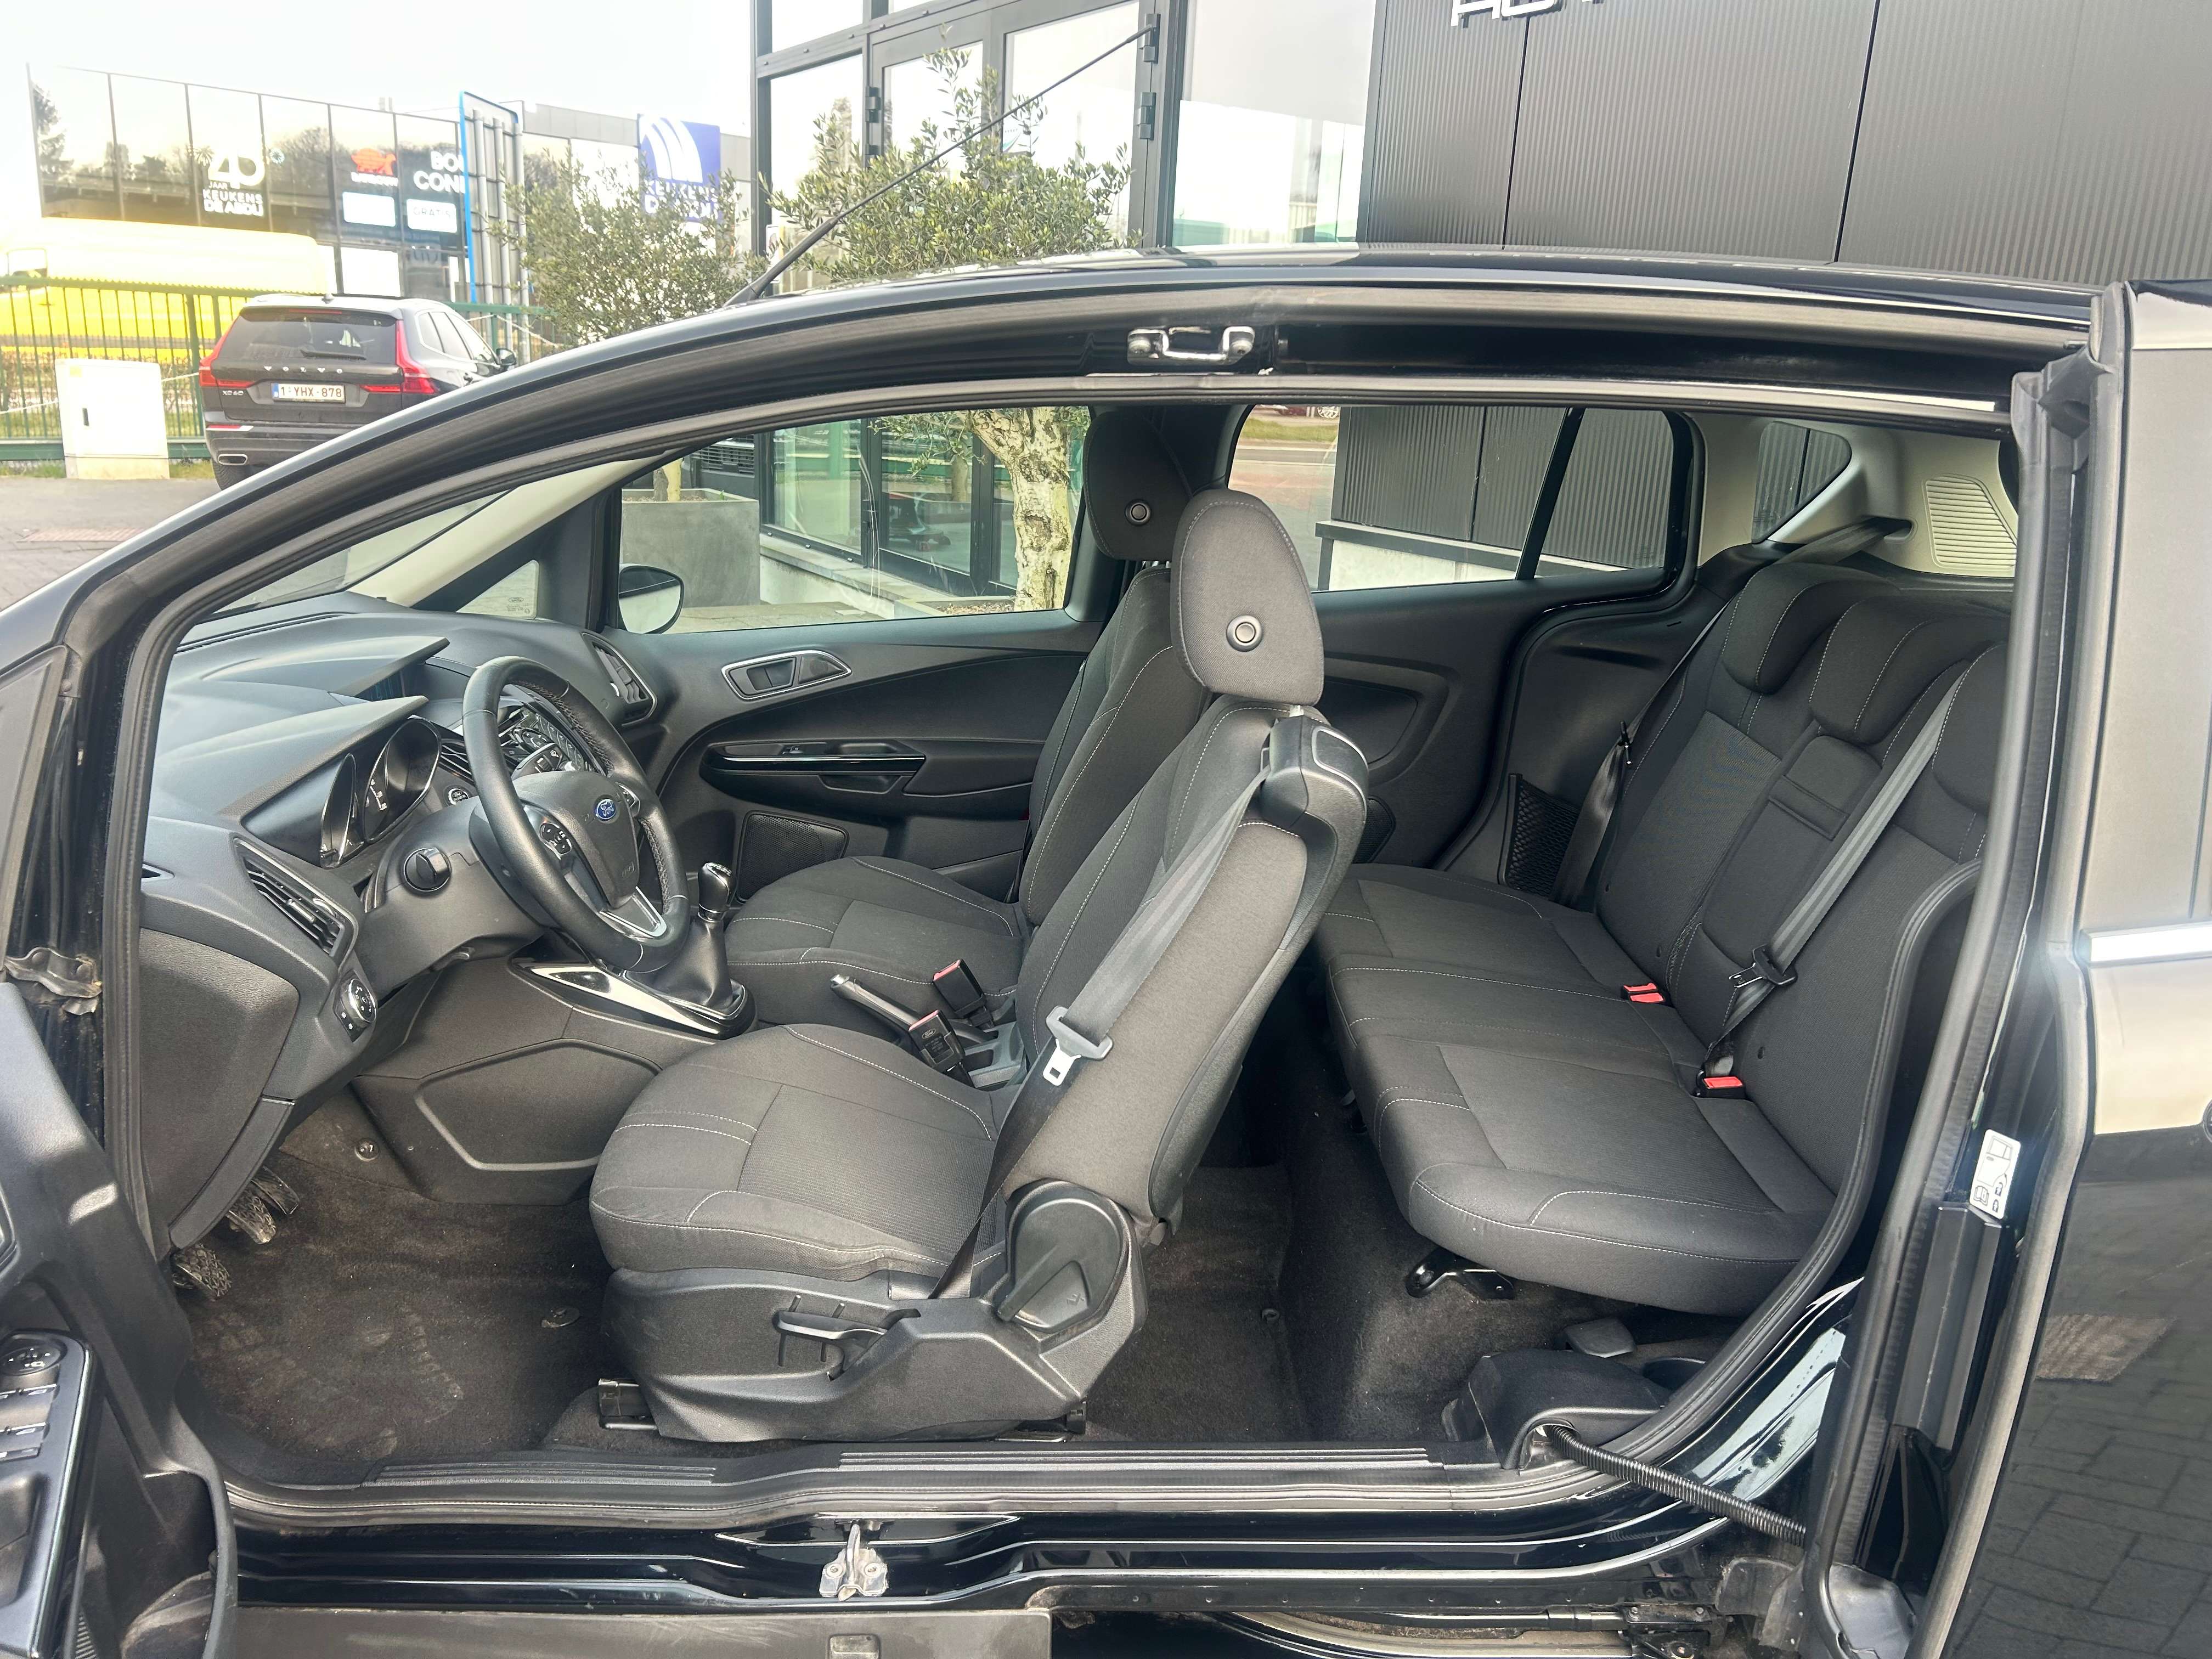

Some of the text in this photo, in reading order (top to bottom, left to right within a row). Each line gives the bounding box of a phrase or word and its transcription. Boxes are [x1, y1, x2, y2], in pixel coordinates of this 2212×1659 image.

[208, 148, 265, 189] 40
[209, 181, 228, 190] JAAR
[202, 189, 263, 205] KEUKENS
[263, 366, 343, 374] VOLVO
